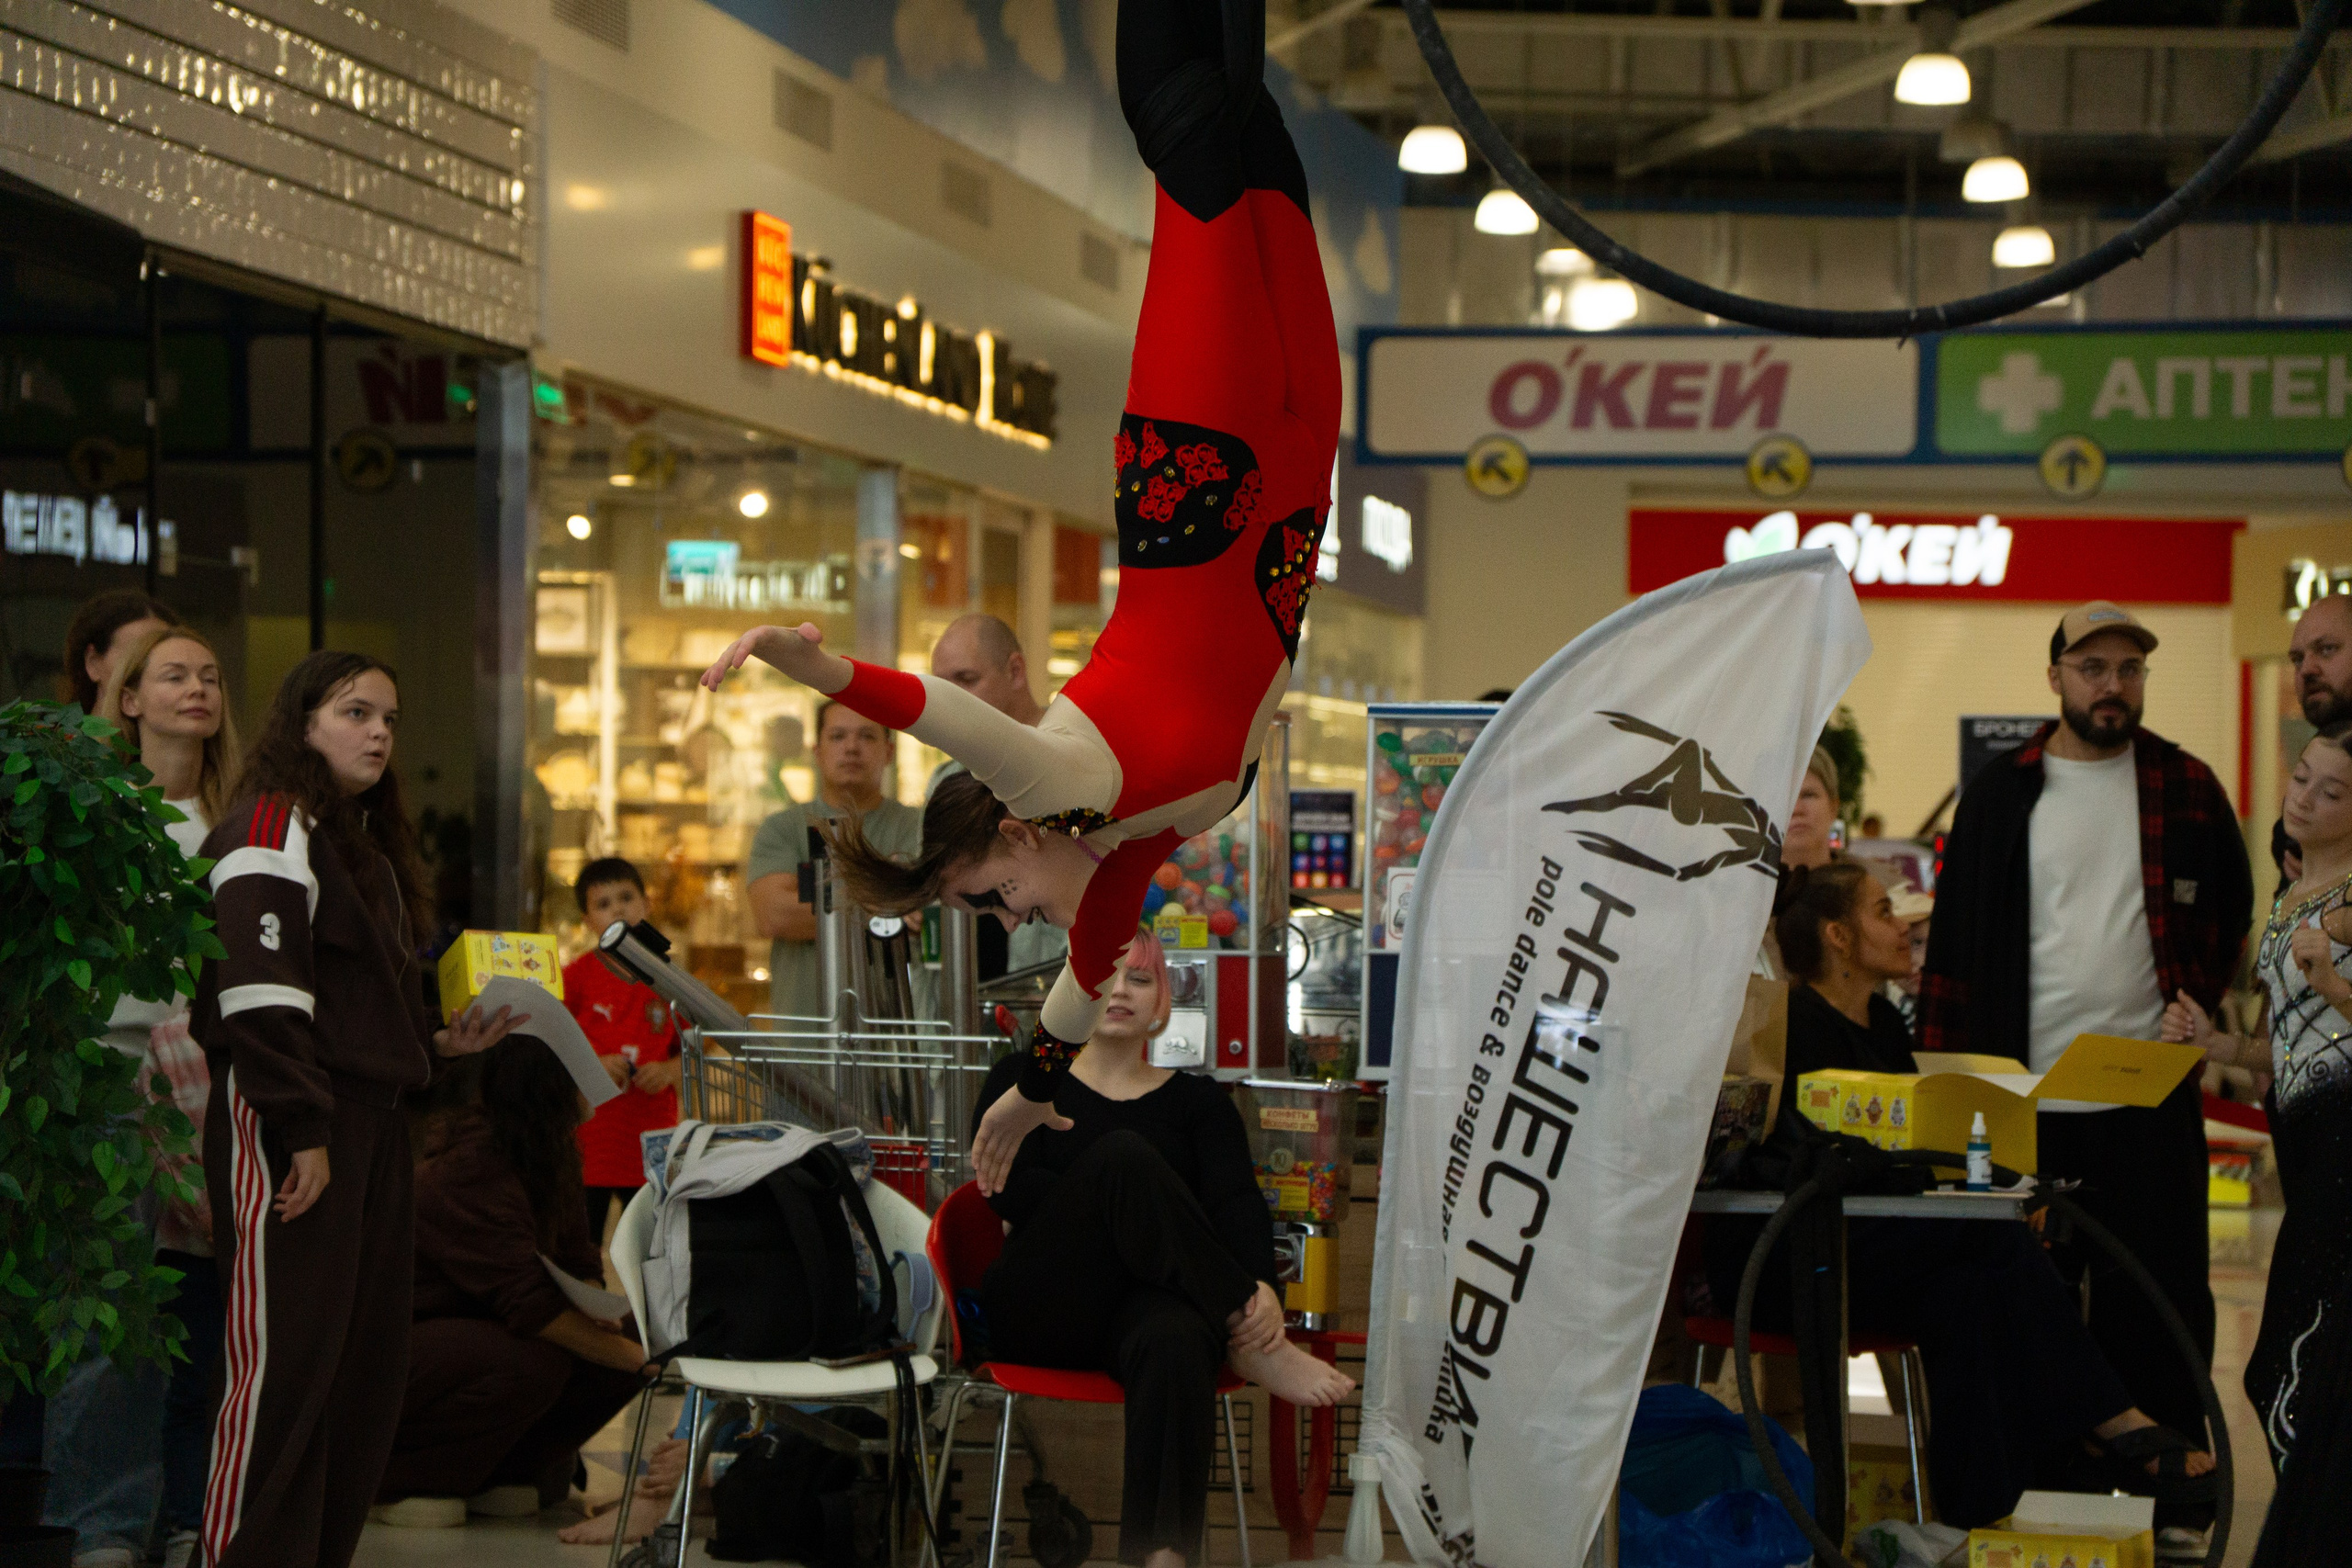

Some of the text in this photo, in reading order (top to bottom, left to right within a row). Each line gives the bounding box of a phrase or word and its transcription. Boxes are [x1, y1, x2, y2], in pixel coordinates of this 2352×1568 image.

[1487, 344, 1791, 430] О'КЕЙ
[1525, 855, 1564, 927] pole
[260, 912, 280, 952] 3
[1490, 933, 1538, 1028] dance
[1479, 1032, 1505, 1057] &
[1449, 882, 1636, 1464] НАШЕСТВИ
